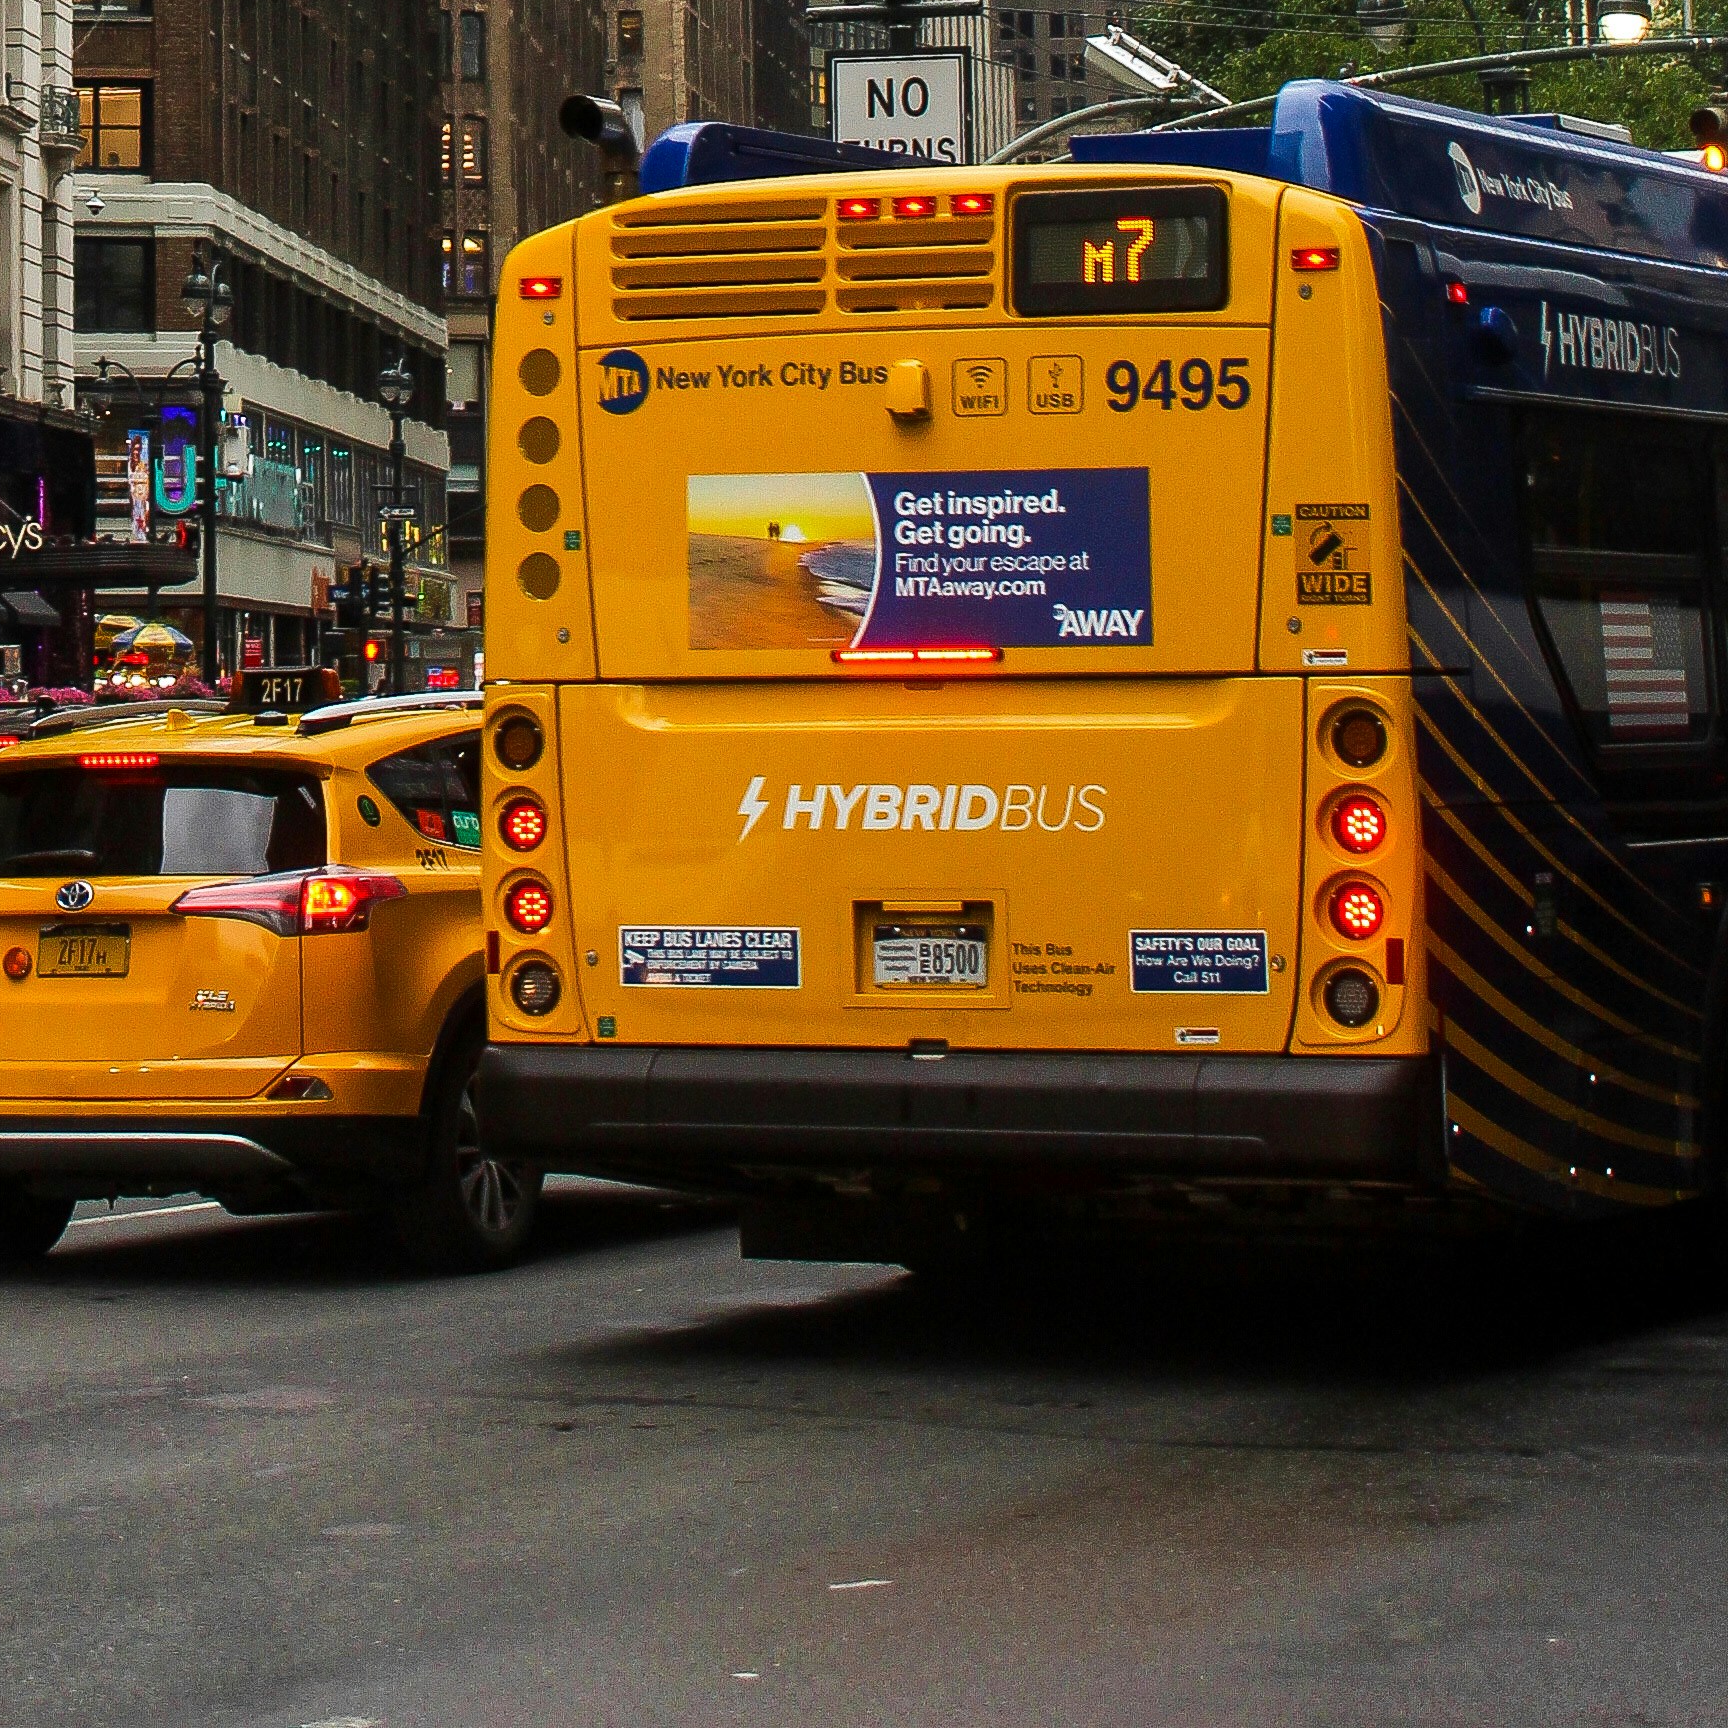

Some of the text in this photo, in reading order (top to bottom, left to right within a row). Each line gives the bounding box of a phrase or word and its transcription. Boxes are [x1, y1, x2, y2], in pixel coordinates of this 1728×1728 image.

[866, 75, 930, 119] NO
[1476, 167, 1506, 197] New
[1500, 172, 1531, 202] York
[1527, 177, 1553, 211] City
[1547, 181, 1573, 210] Bus
[1557, 312, 1681, 378] HYBRIDBUS
[596, 357, 888, 410] MTA New York City Bus
[1105, 357, 1251, 412] 9495
[1037, 393, 1074, 408] USB
[893, 488, 1067, 519] Get inspired.
[1299, 505, 1367, 518] CAUTION
[893, 518, 1032, 549] Get going.
[895, 551, 1090, 576] Find your escape at
[895, 576, 1047, 600] MTAaway.com
[1302, 574, 1368, 593] WIDE
[1058, 609, 1144, 637] AWAY
[261, 678, 303, 702] 2F17
[782, 784, 1108, 833] HYBRIDBUS
[624, 931, 793, 948] KEEP BUS LANES CLEAR
[1012, 943, 1073, 957] This Bus
[1197, 938, 1223, 951] OUR
[1226, 938, 1261, 951] GOAL
[932, 943, 980, 974] 8500
[1012, 962, 1116, 975] Uses Clean-Air
[1135, 955, 1260, 969] How Are We Doing?
[1013, 980, 1094, 997] Technology
[1174, 971, 1221, 983] Call 511
